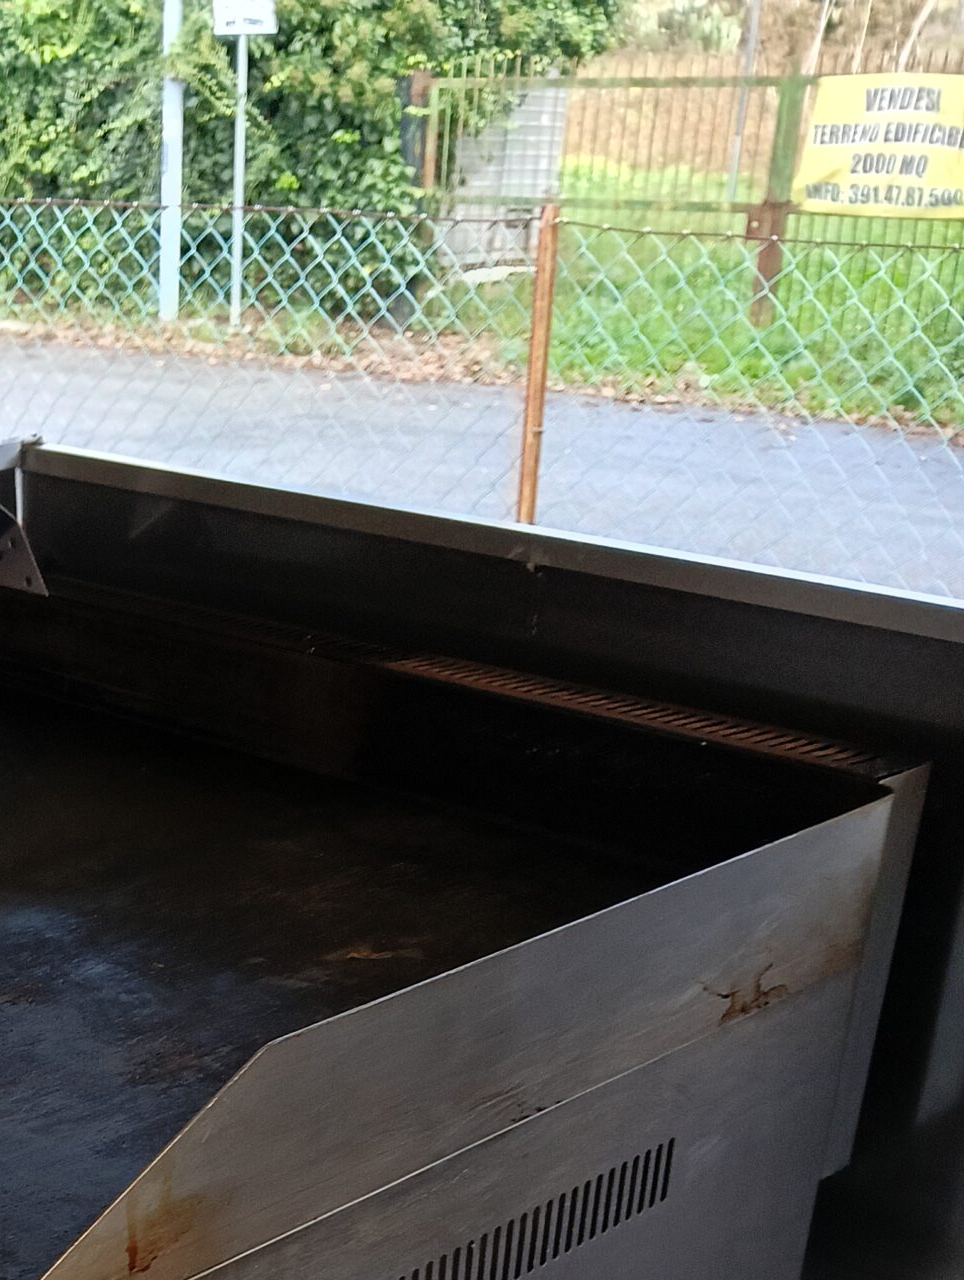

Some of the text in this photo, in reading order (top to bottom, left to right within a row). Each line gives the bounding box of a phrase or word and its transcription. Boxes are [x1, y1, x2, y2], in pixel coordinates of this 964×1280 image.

[865, 87, 942, 113] VENDESI
[813, 123, 880, 145] TERRENO
[850, 153, 930, 178] 2000 MQ
